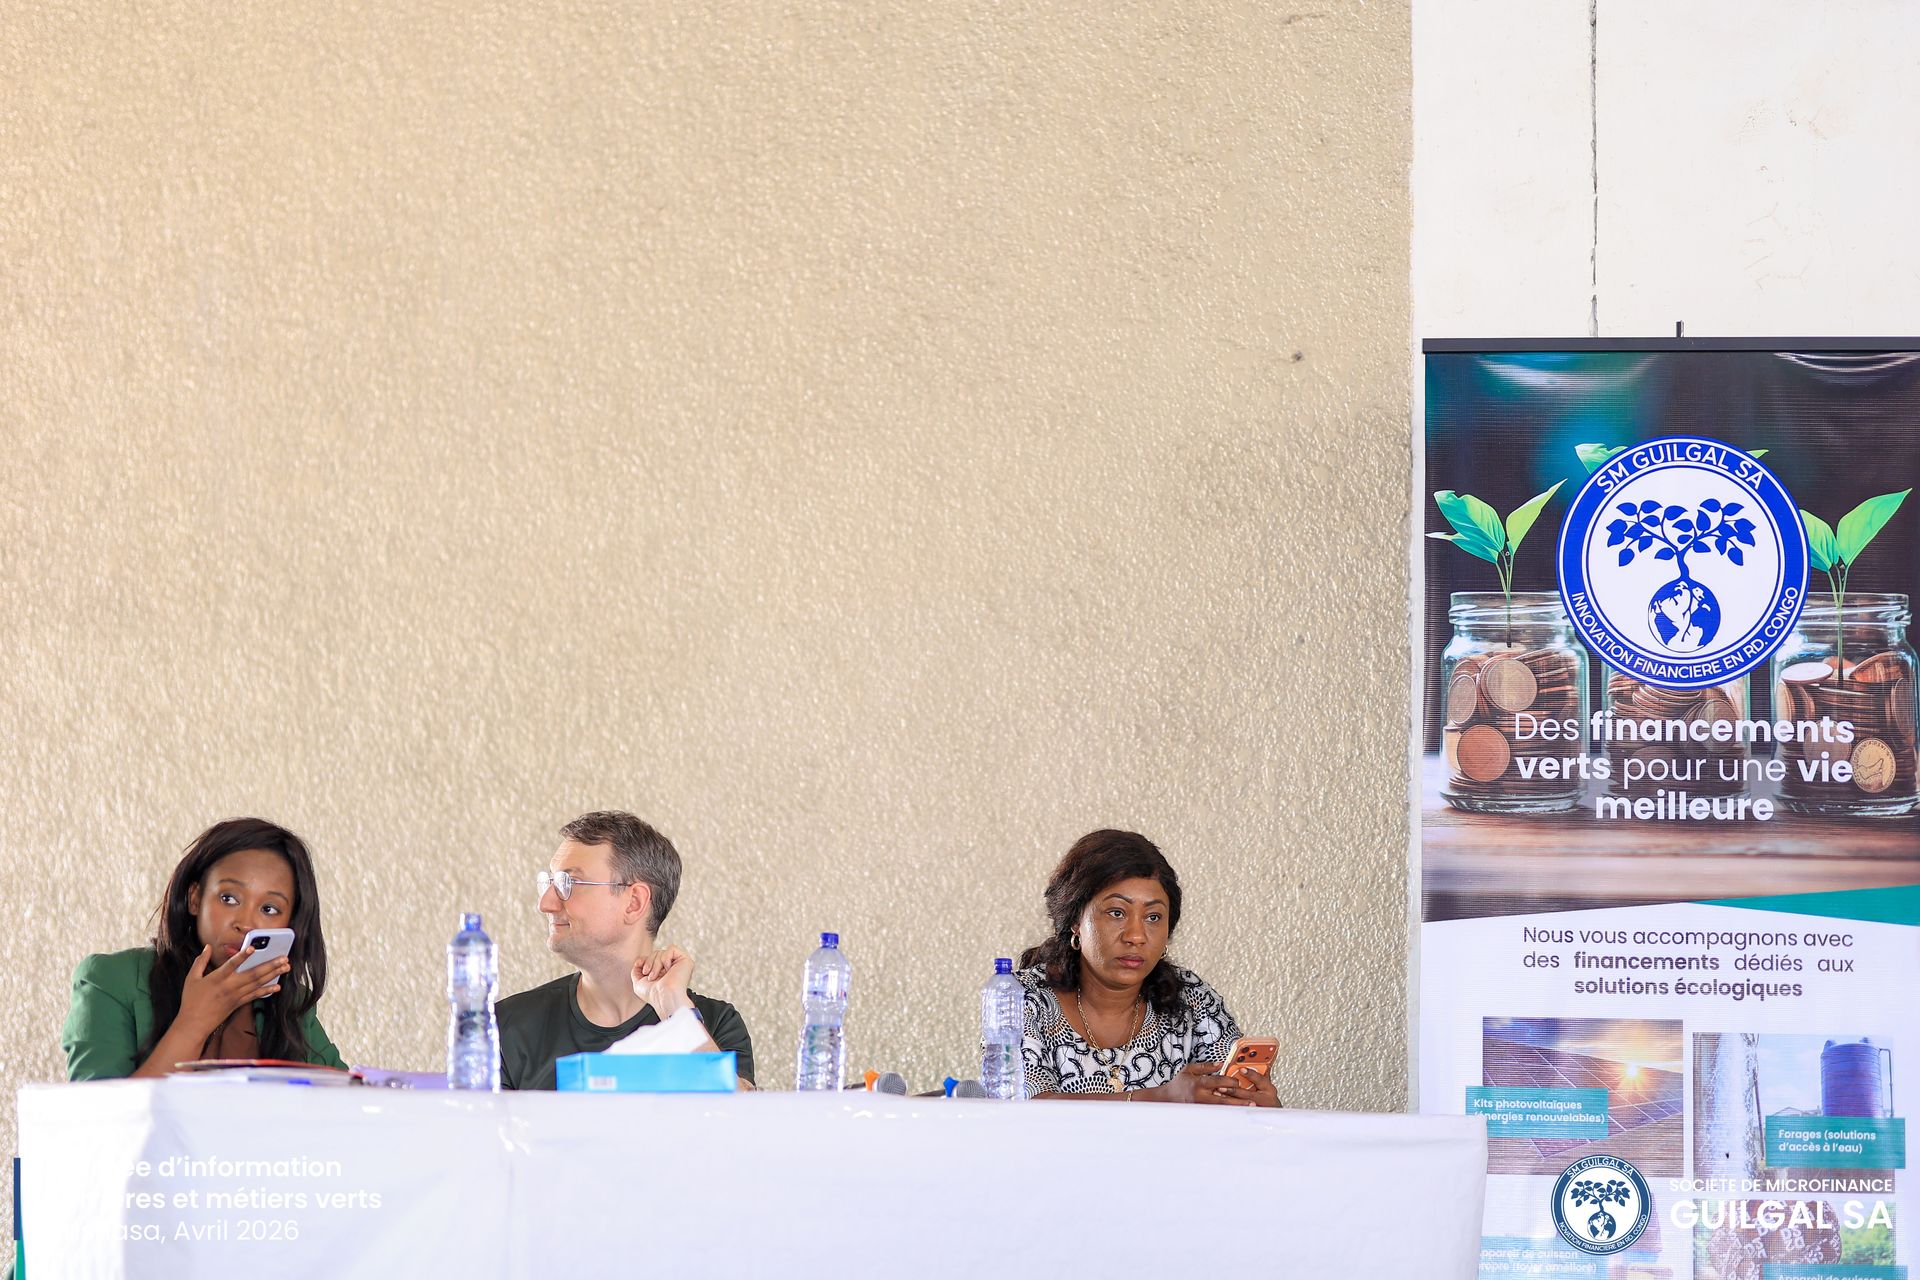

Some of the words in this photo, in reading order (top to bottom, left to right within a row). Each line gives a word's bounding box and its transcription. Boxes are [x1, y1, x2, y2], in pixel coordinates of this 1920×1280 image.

[1597, 462, 1631, 494] SM
[1632, 444, 1729, 470] GUILGAL
[1734, 460, 1764, 490] SA
[1572, 592, 1636, 667] INNOVATION
[1633, 656, 1722, 680] FINANCIERE
[1725, 653, 1745, 670] EN
[1742, 640, 1768, 659] RD.
[1764, 586, 1798, 638] CONGO
[1515, 713, 1580, 741] Des
[1591, 710, 1855, 744] financements
[1514, 753, 1611, 780] verts
[1623, 758, 1707, 790] pour
[1718, 759, 1787, 782] une
[1797, 751, 1854, 783] vie
[1595, 789, 1774, 821] meilleure
[1523, 927, 1574, 943] Nous
[1579, 930, 1628, 944] vous
[1633, 931, 1798, 951] accompagnons
[1803, 933, 1854, 947] avec
[1523, 951, 1560, 968] des
[1574, 951, 1720, 970] financements
[1734, 953, 1803, 971] dédiés
[1817, 958, 1854, 972] aux
[1574, 977, 1669, 995] solutions
[1674, 977, 1803, 1001] écologiques
[1473, 1098, 1494, 1108] Kits
[1495, 1099, 1583, 1112] photovoltaïques
[1526, 1112, 1605, 1124] renouvelables)
[1778, 1129, 1822, 1141] Forages
[1824, 1129, 1876, 1141] (solutions
[1823, 1142, 1831, 1152] à
